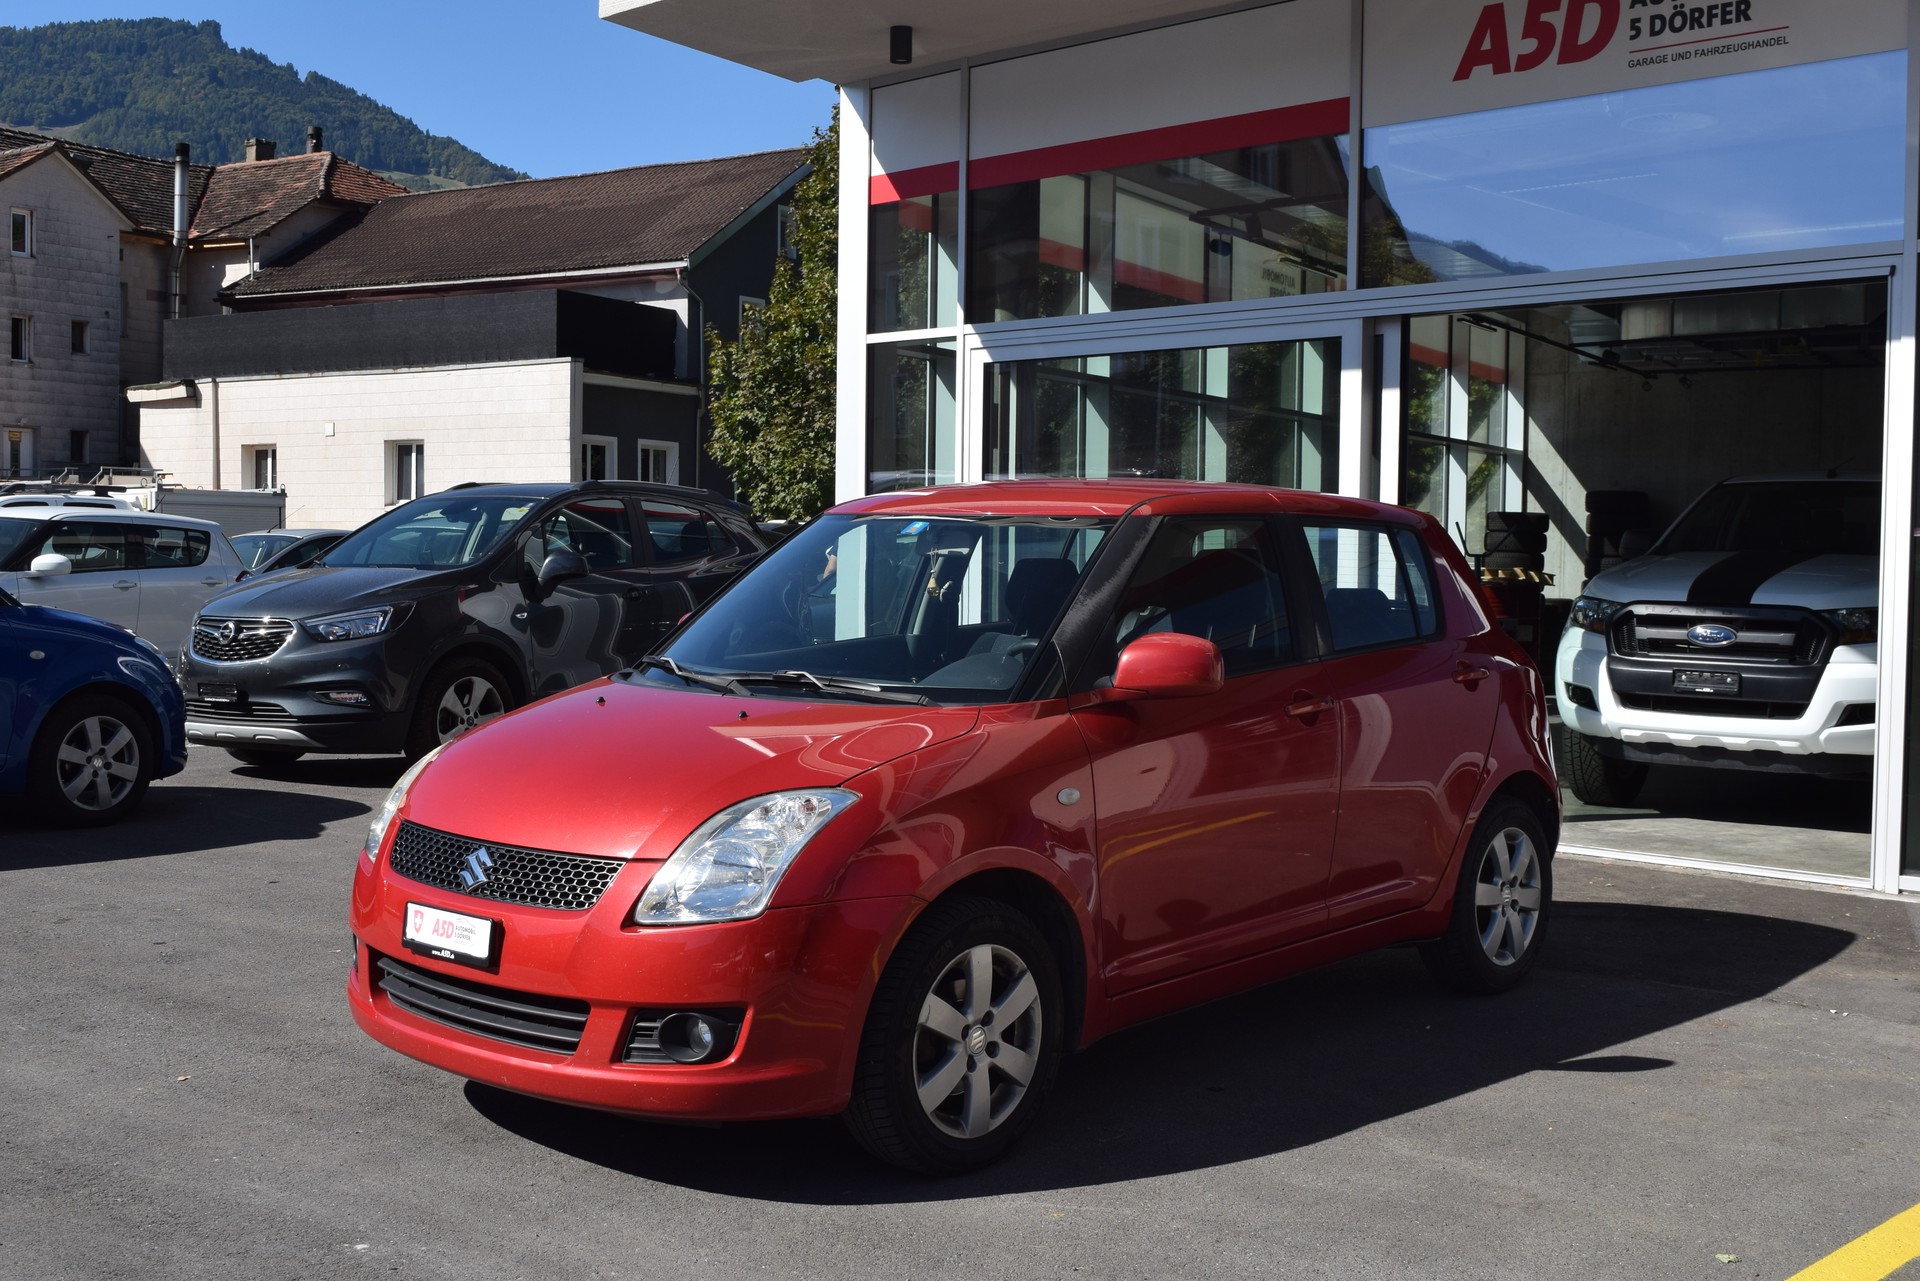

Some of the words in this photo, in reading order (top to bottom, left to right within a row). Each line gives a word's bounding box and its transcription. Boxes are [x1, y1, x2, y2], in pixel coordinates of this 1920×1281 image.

[1629, 17, 1642, 41] 5
[1649, 0, 1753, 38] DÖRFER
[1452, 0, 1621, 82] A5D
[1628, 54, 1669, 69] GARAGE
[1671, 50, 1692, 62] UND
[1694, 35, 1790, 59] FAHRZEUGHANDEL
[432, 918, 455, 939] A5D
[455, 925, 476, 935] AUTOMOBIL
